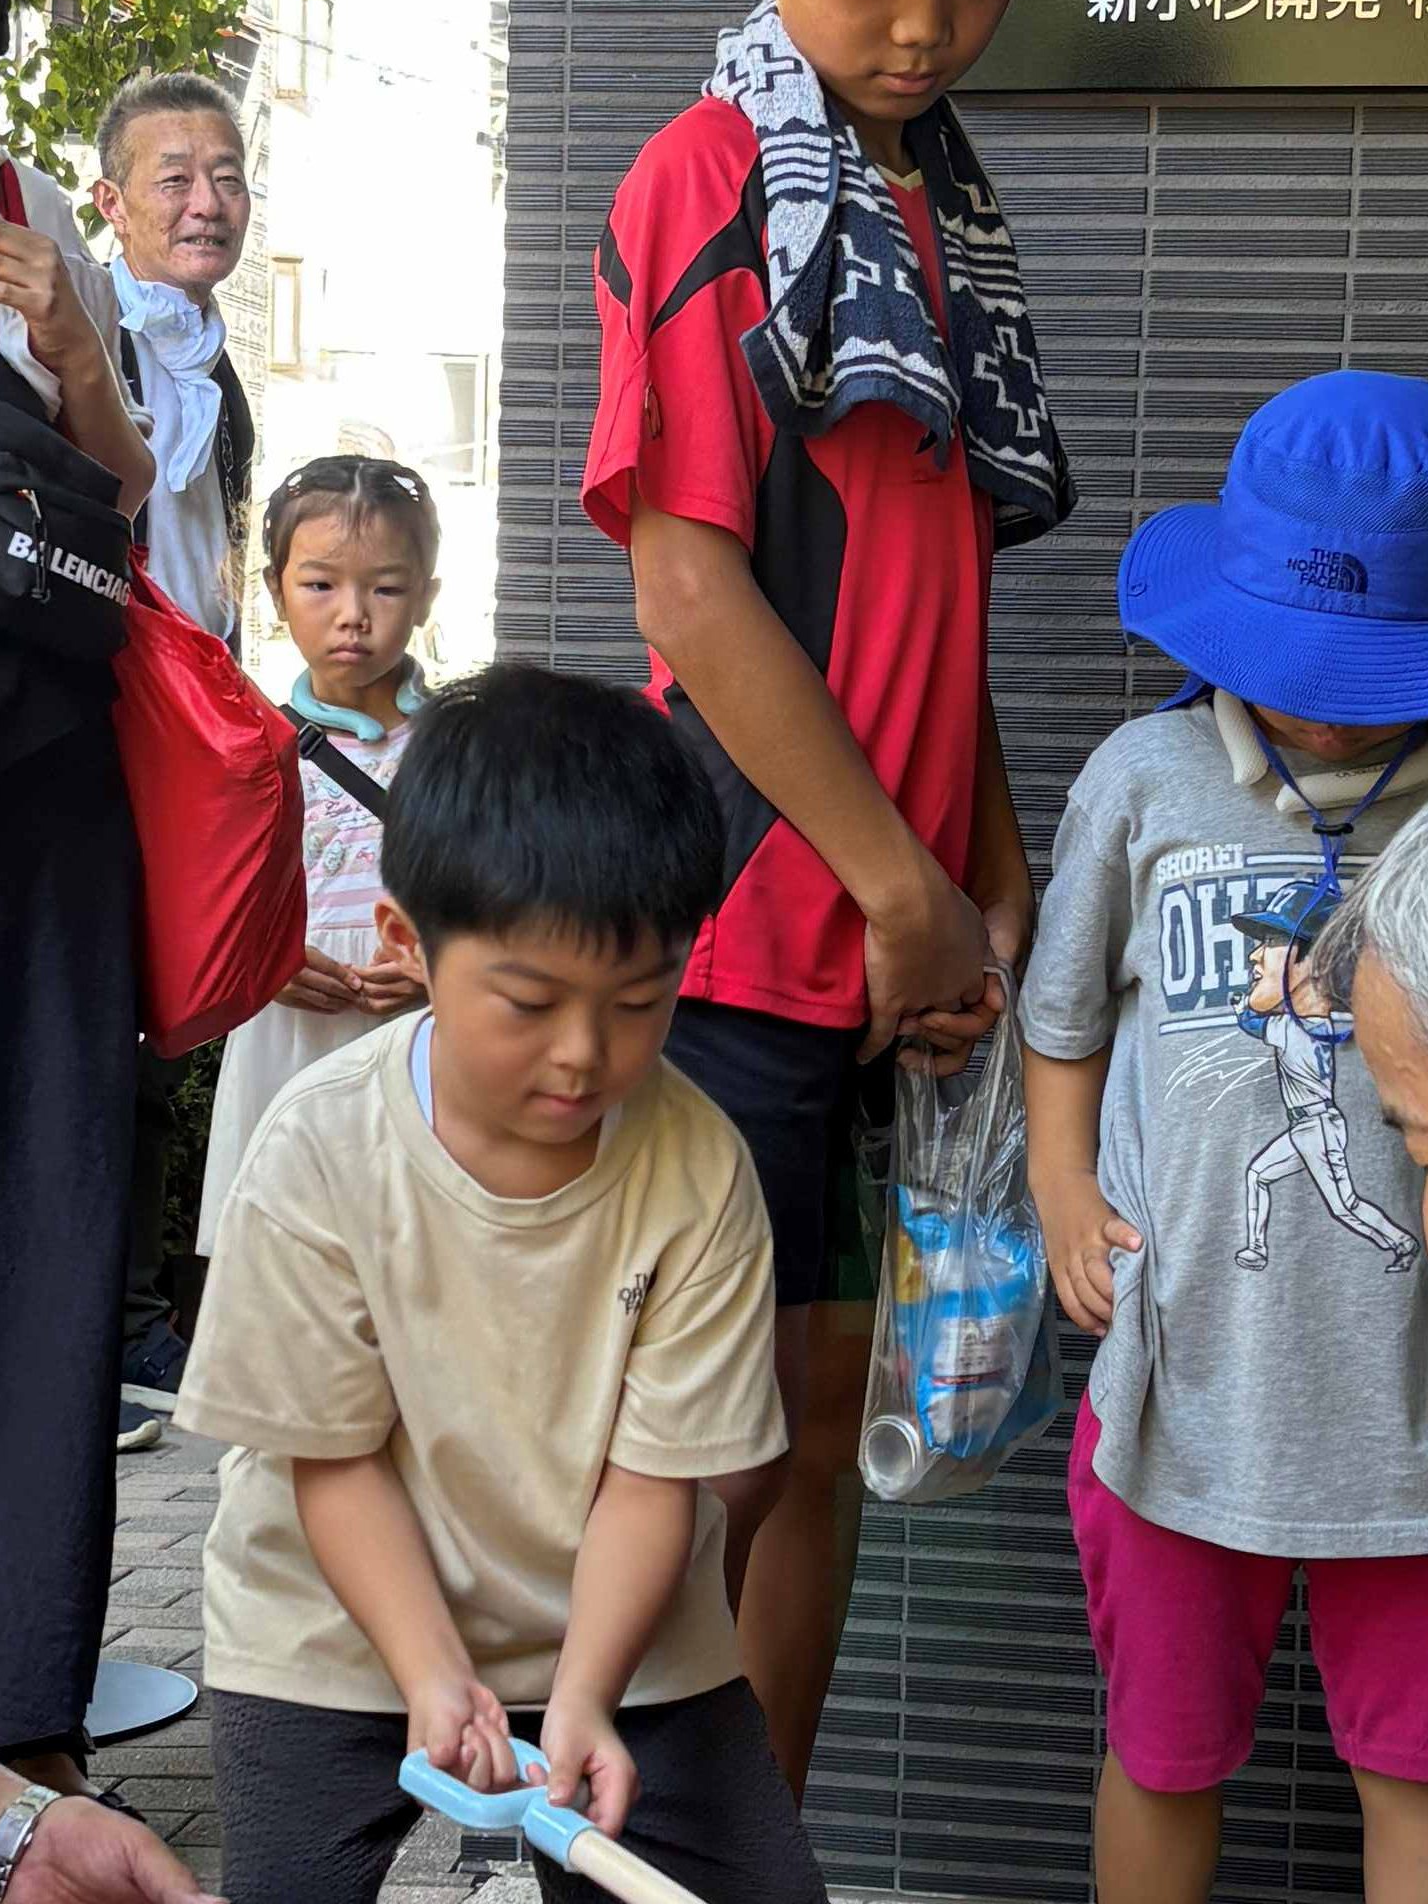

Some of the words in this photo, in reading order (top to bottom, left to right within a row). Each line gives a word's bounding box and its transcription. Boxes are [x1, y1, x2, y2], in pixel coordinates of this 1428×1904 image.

[1311, 548, 1342, 563] THE
[1287, 558, 1339, 577] NORTH
[1300, 573, 1336, 589] FACE
